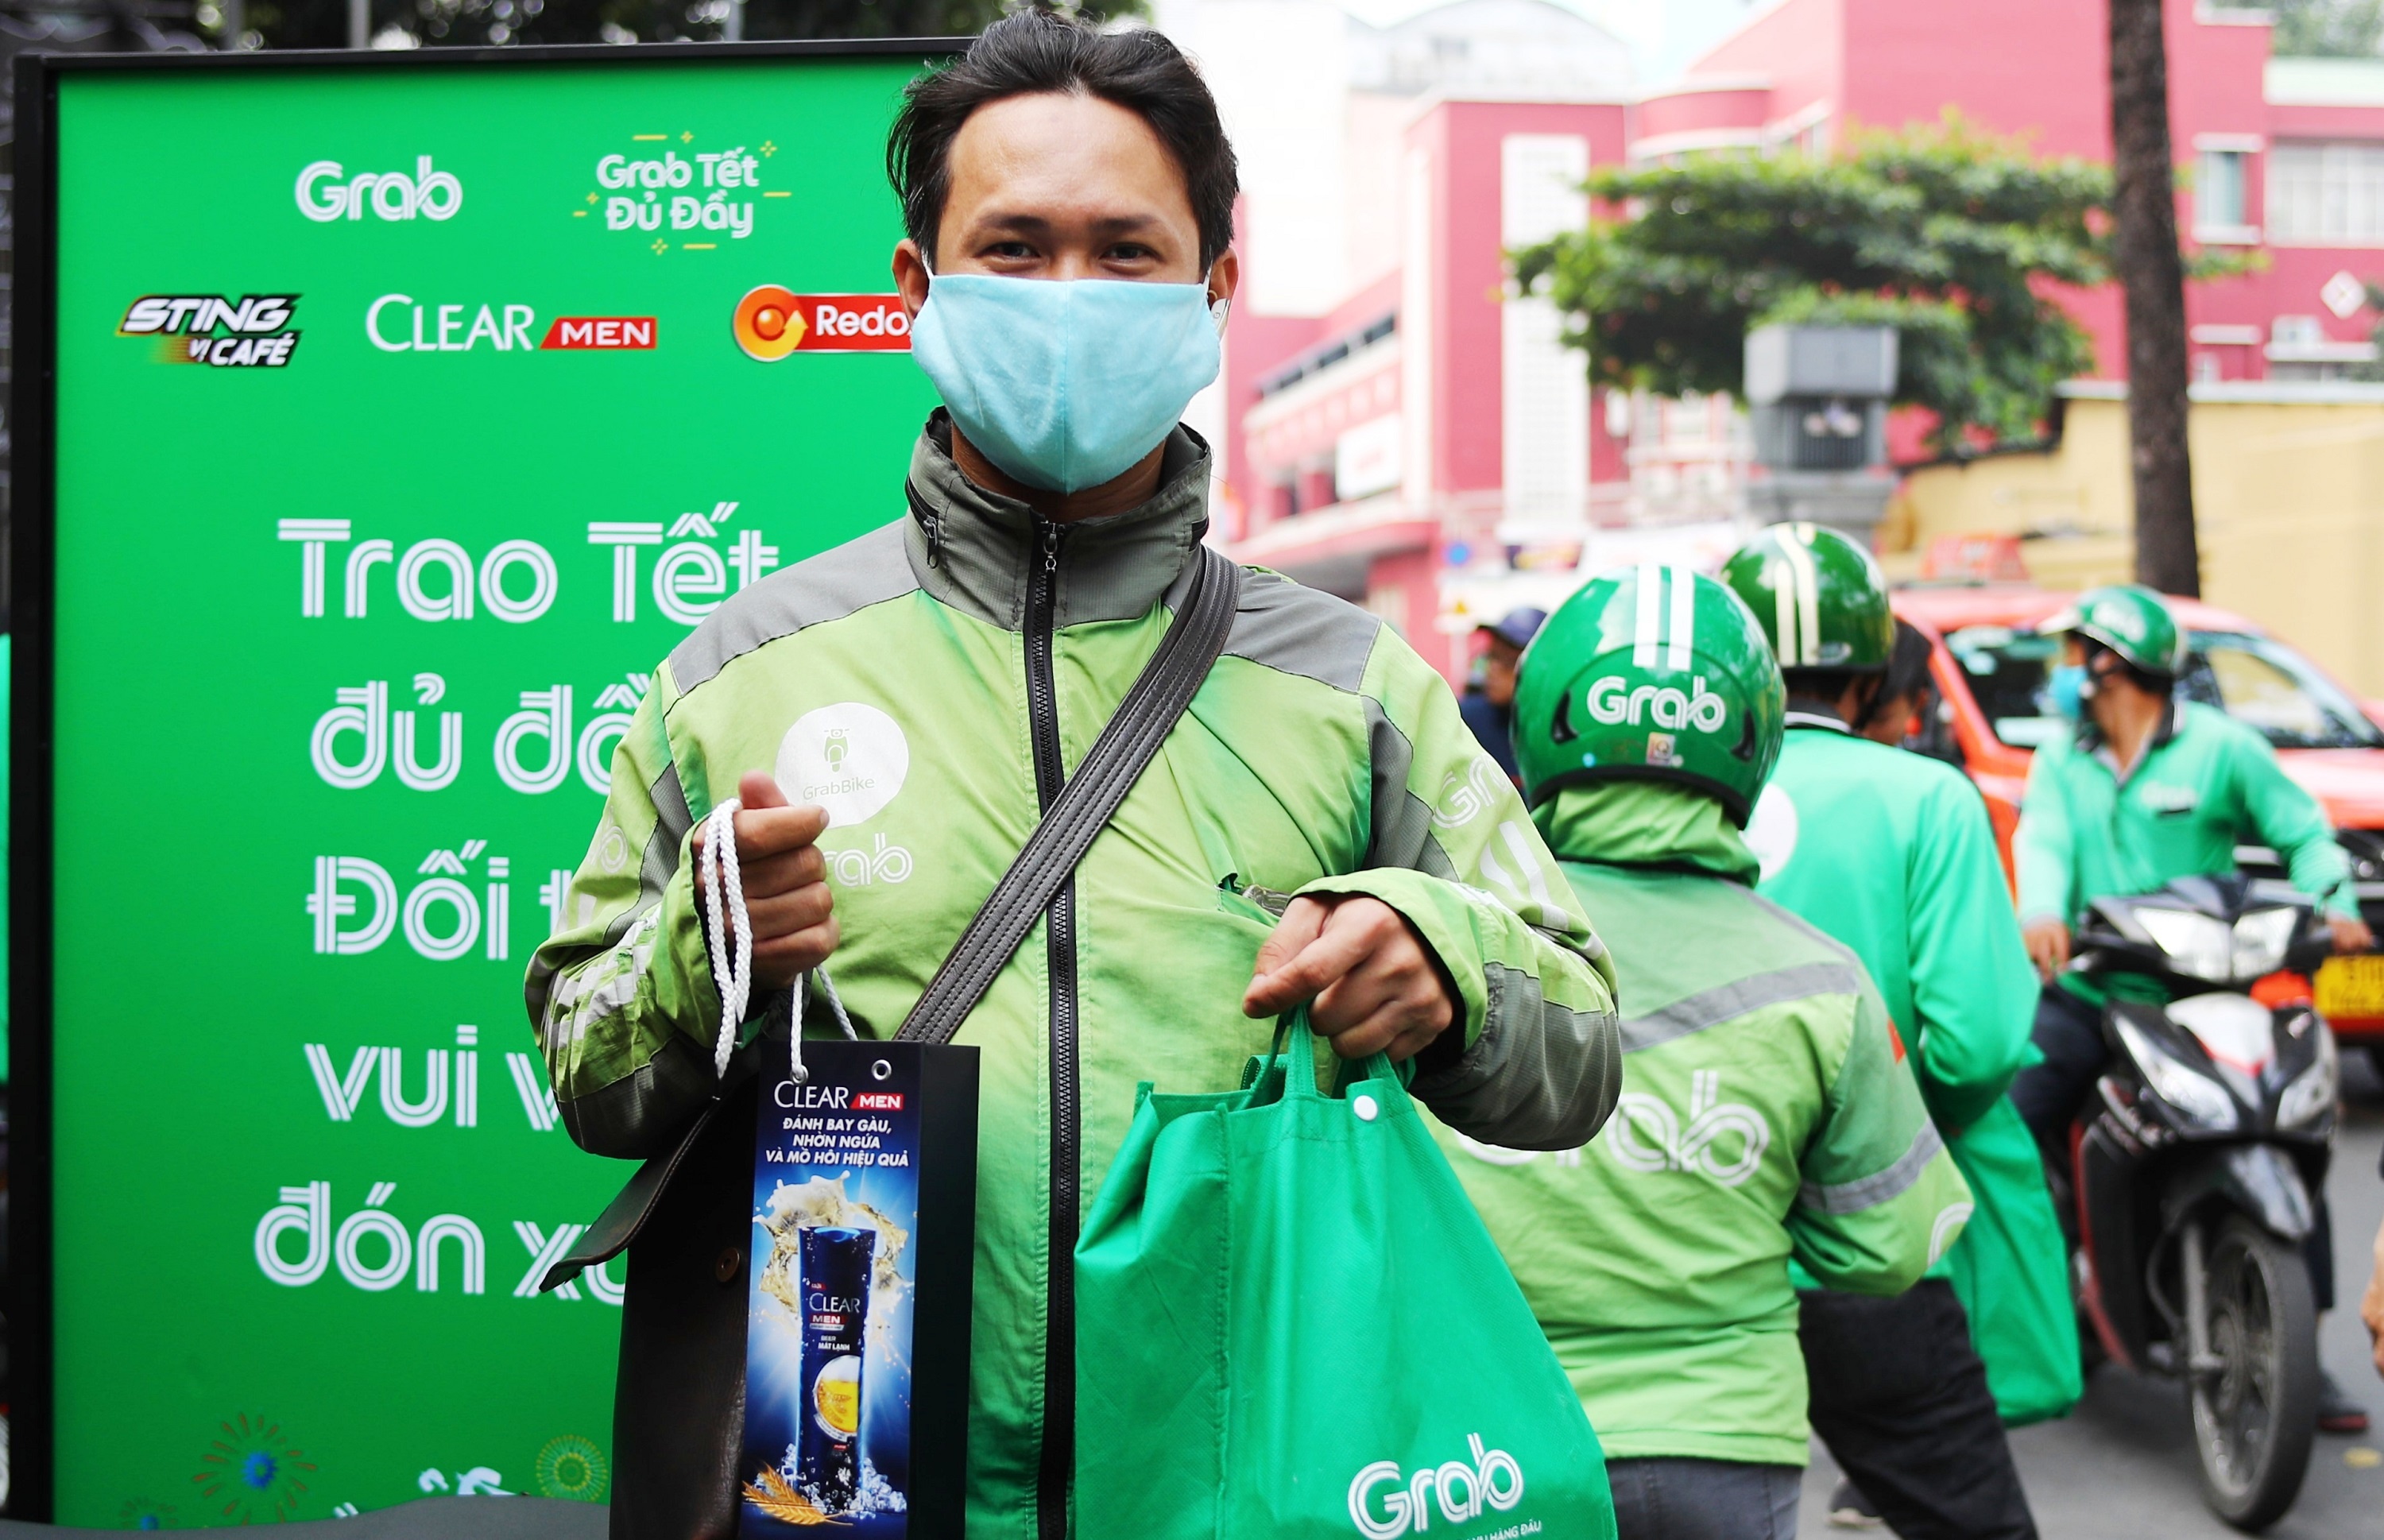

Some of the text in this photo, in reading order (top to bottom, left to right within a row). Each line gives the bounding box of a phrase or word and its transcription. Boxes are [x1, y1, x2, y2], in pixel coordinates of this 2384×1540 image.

[295, 155, 463, 222] Grab
[596, 146, 760, 190] Grab Tết
[605, 189, 754, 239] Đủ Đầy
[122, 297, 292, 334] STING
[366, 293, 651, 353] CLEAR MEN
[815, 304, 911, 337] Redo
[210, 332, 296, 366] CAFÉ
[277, 501, 780, 626] Trao Tết
[1586, 675, 1726, 733] Grab
[310, 672, 462, 791] đủ
[802, 776, 876, 801] GrabBike
[306, 839, 509, 961] Đối
[304, 1024, 478, 1128] vui
[773, 1080, 901, 1110] CLEAR MEN
[783, 1114, 892, 1134] ĐÁNH BAY GÀU,
[792, 1132, 881, 1149] NHỜN NGỨA
[765, 1147, 909, 1167] VÀ MỒ HÔI HIỆU QUẢ
[254, 1180, 486, 1294] đón
[809, 1292, 861, 1314] CLEAR
[812, 1314, 841, 1324] MEN
[1347, 1432, 1524, 1540] Grab
